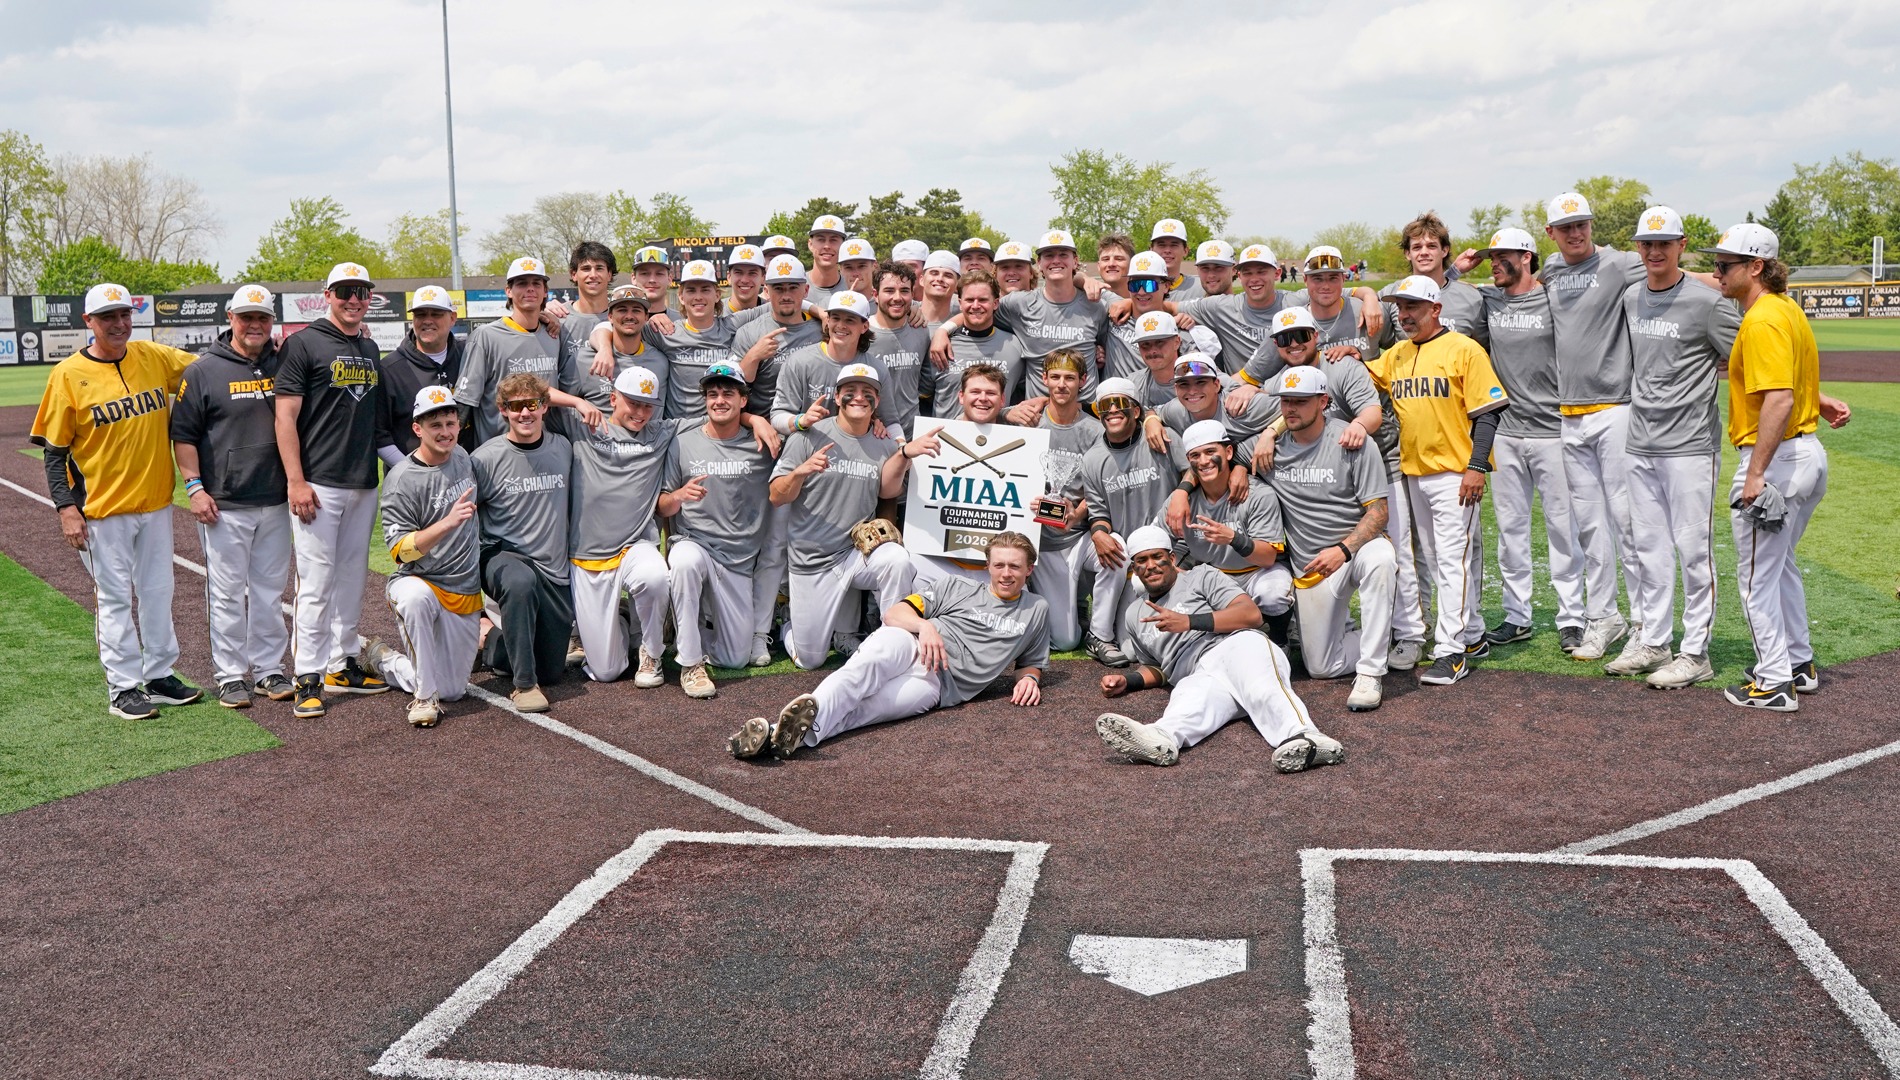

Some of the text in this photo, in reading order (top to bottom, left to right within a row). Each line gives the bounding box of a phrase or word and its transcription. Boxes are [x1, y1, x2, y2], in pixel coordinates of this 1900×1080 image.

[673, 237, 746, 247] NICOLAY FIELD
[1560, 274, 1599, 291] CHAMPS.
[1869, 287, 1899, 295] ADRIAN
[1820, 297, 1843, 306] 2024
[1887, 296, 1900, 305] 20
[1501, 313, 1544, 330] CHAMPS.
[1639, 318, 1681, 339] CHAMPS.
[1042, 325, 1086, 341] CHAMPS.
[883, 353, 920, 368] CHAMPS.
[229, 378, 274, 393] ADRI
[1391, 377, 1450, 400] DRIAN
[91, 387, 167, 428] ADRIAN
[707, 460, 752, 476] CHAMPS.
[837, 459, 878, 480] CHAMPS.
[1291, 467, 1337, 483] CHAMPS.
[523, 474, 565, 493] CHAMPS.
[1117, 466, 1160, 490] CHAMPS.
[930, 474, 1022, 509] MIAA
[943, 508, 1005, 521] TOURNAMENT
[946, 516, 1000, 529] CHAMPIONS
[955, 534, 988, 547] 2026
